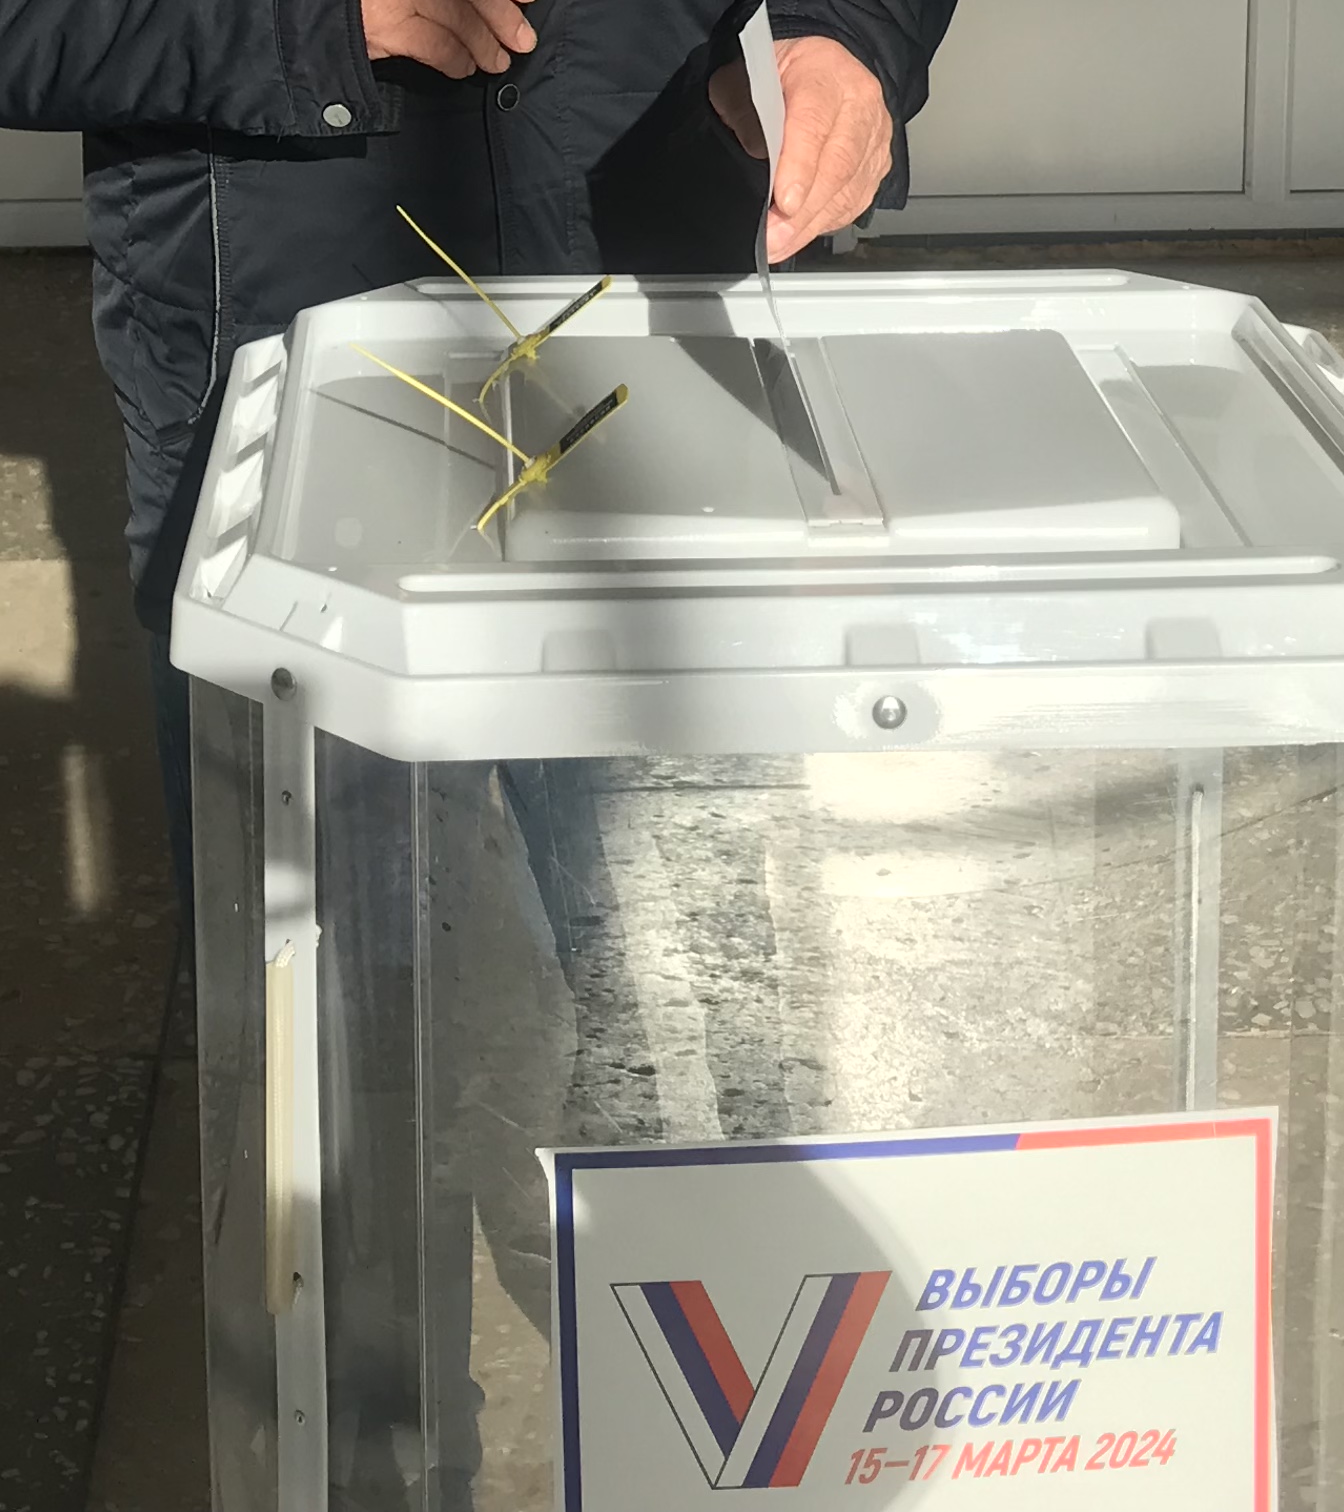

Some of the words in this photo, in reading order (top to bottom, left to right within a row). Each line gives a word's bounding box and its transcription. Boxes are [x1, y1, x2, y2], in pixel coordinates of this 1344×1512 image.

[915, 1255, 1158, 1312] ВЫБОРЫ
[888, 1311, 1225, 1373] ПРЕЗИДЕНТА
[861, 1378, 1082, 1433] РОССИИ
[844, 1443, 952, 1486] 15–17
[951, 1434, 1082, 1480] МАРТА
[1084, 1428, 1177, 1471] 2024
